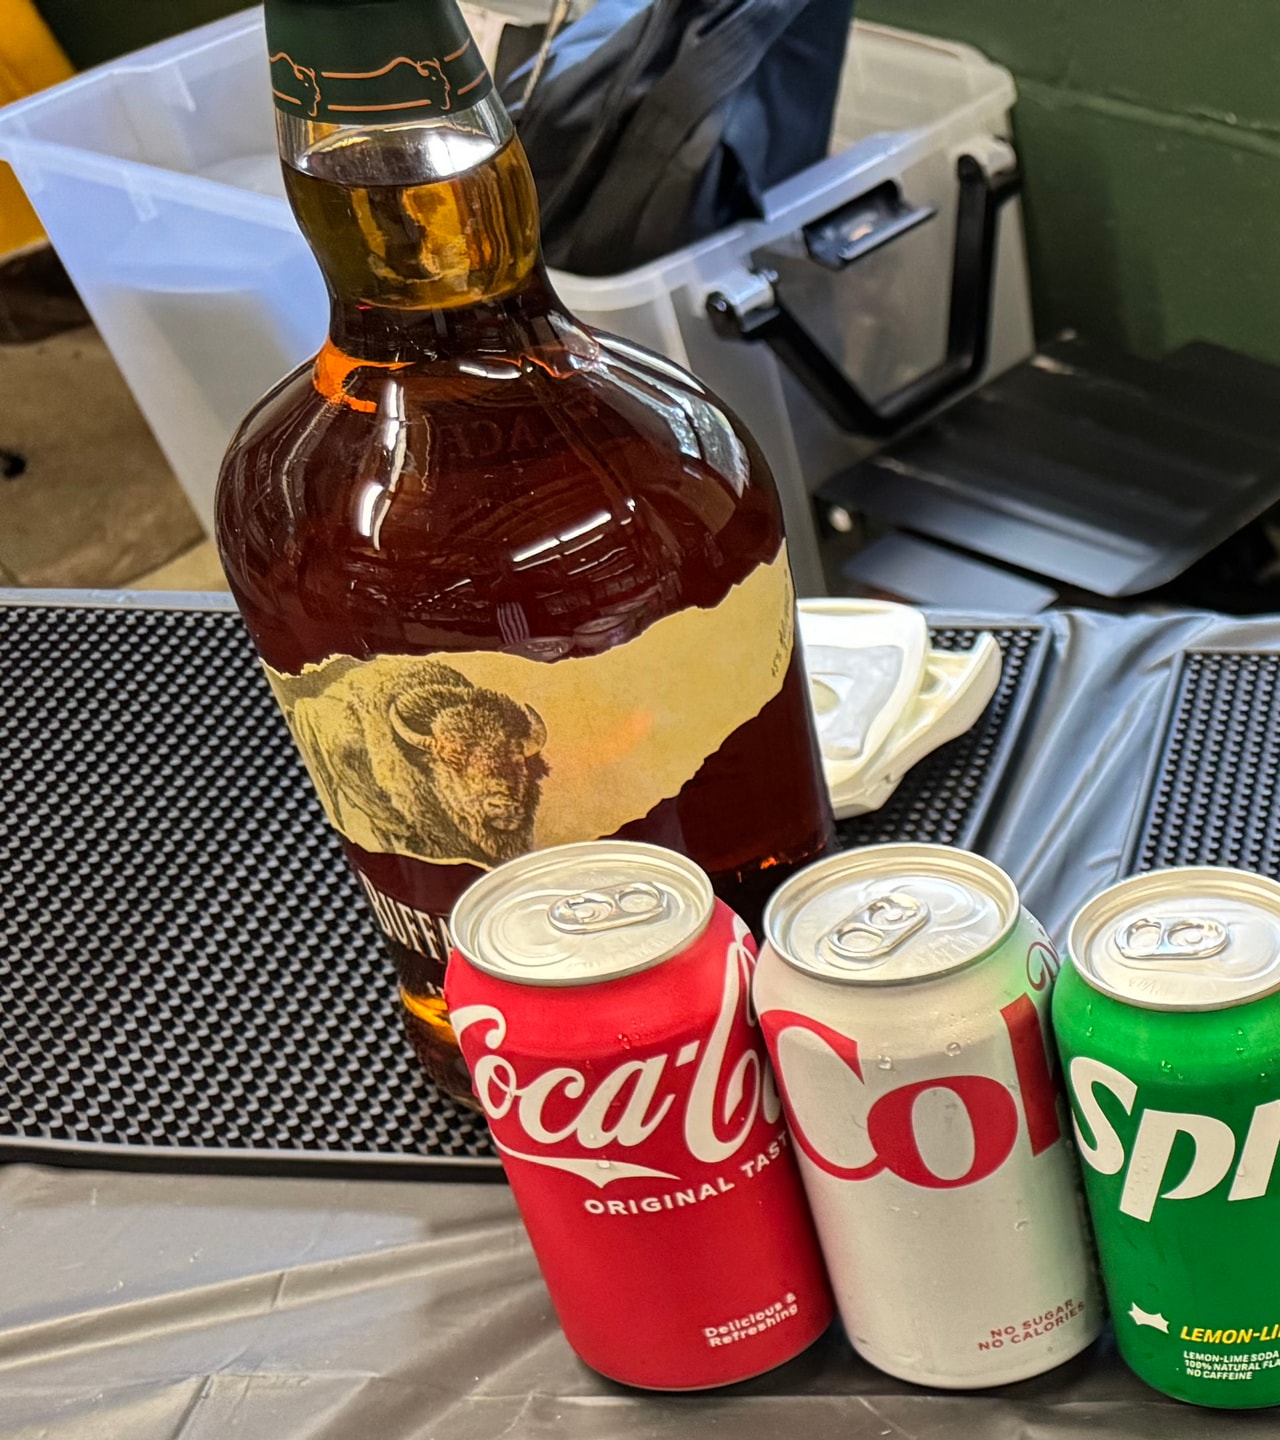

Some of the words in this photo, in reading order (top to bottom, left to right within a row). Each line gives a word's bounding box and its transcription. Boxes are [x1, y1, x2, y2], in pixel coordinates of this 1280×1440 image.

[358, 869, 456, 961] BUFFA
[449, 914, 784, 1187] Coca-C
[759, 992, 1061, 1190] Co
[584, 1176, 735, 1216] ORIGINAL
[740, 1129, 789, 1179] TAST
[704, 1301, 783, 1338] Delicious
[708, 1303, 799, 1348] Refreshing
[977, 1339, 1004, 1351] NO
[1010, 1301, 1086, 1344] CALORIES
[989, 1325, 1016, 1339] NO
[1022, 1298, 1074, 1330] SUGAR
[1183, 1350, 1249, 1363] LEMON-LIME
[1250, 1350, 1280, 1363] SODA
[1184, 1359, 1212, 1371] 100%
[1213, 1360, 1261, 1373] NATURAL
[1186, 1368, 1201, 1378] NO
[1202, 1370, 1254, 1381] CAFFEINE
